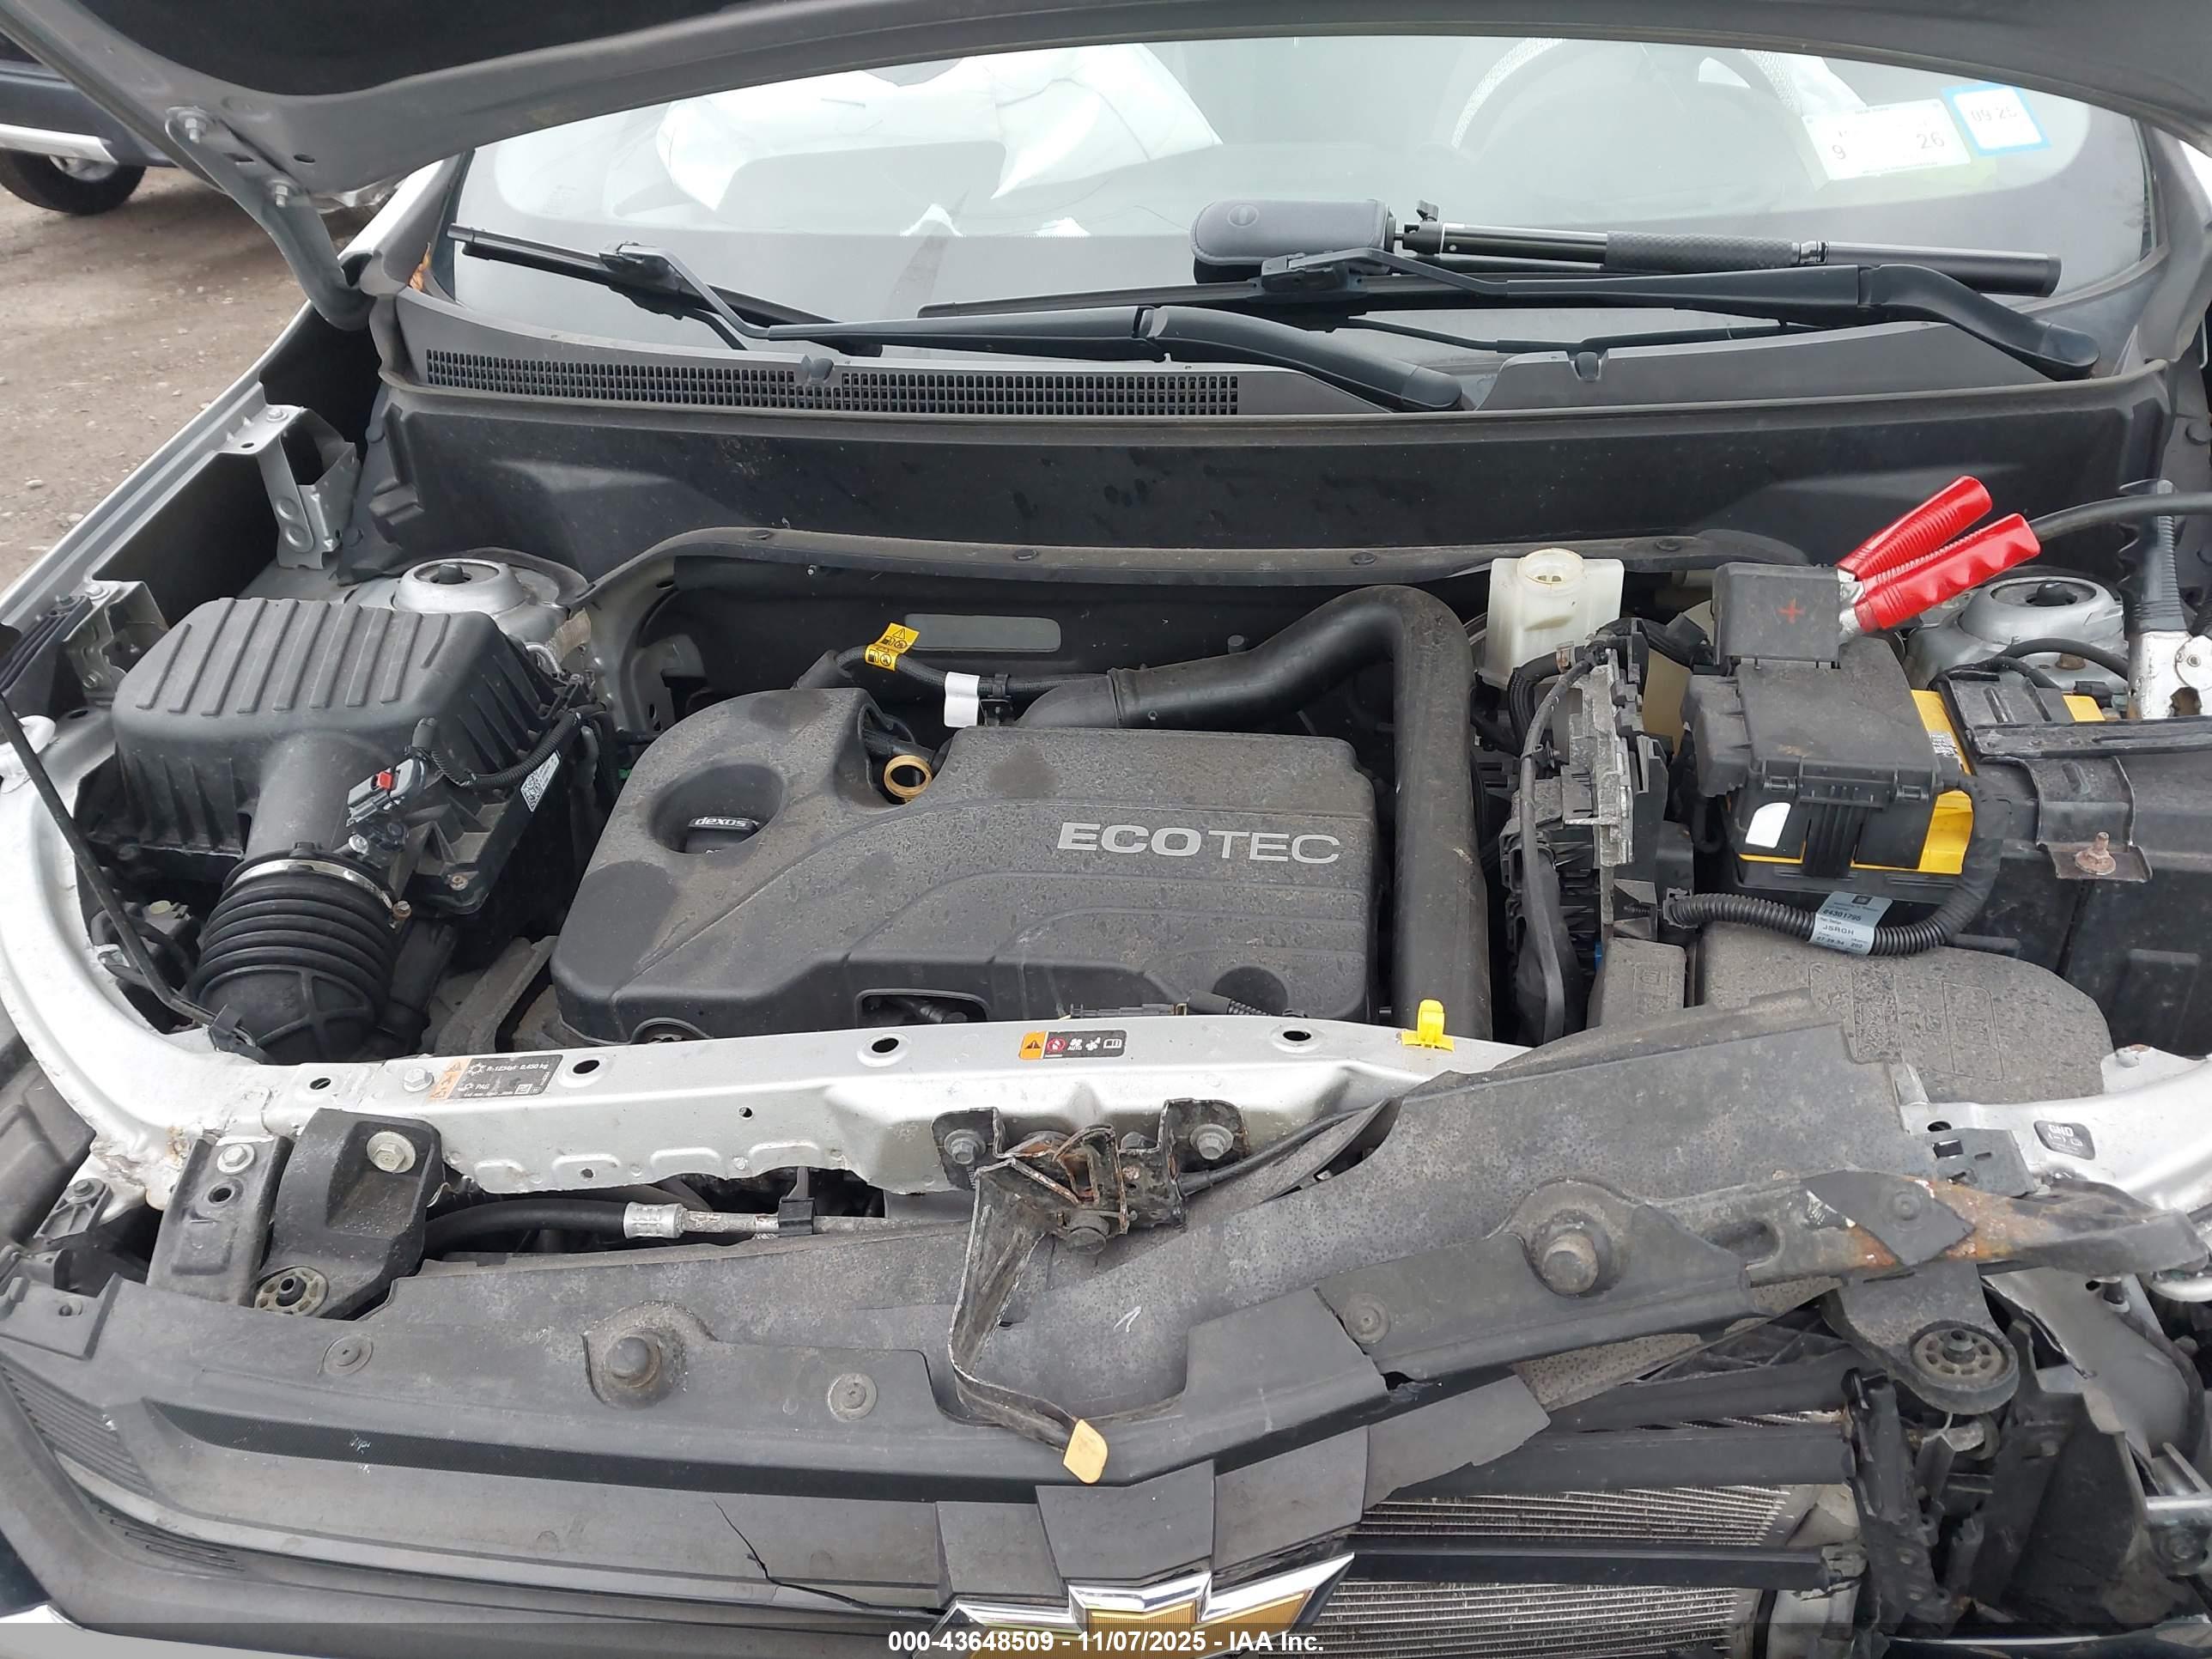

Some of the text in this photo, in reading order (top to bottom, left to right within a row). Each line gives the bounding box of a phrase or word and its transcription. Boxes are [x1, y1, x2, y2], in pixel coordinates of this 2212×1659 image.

[1916, 131, 1945, 149] 26
[1832, 144, 1846, 160] 9
[695, 817, 747, 827] dexos
[2048, 1124, 2074, 1137] GND
